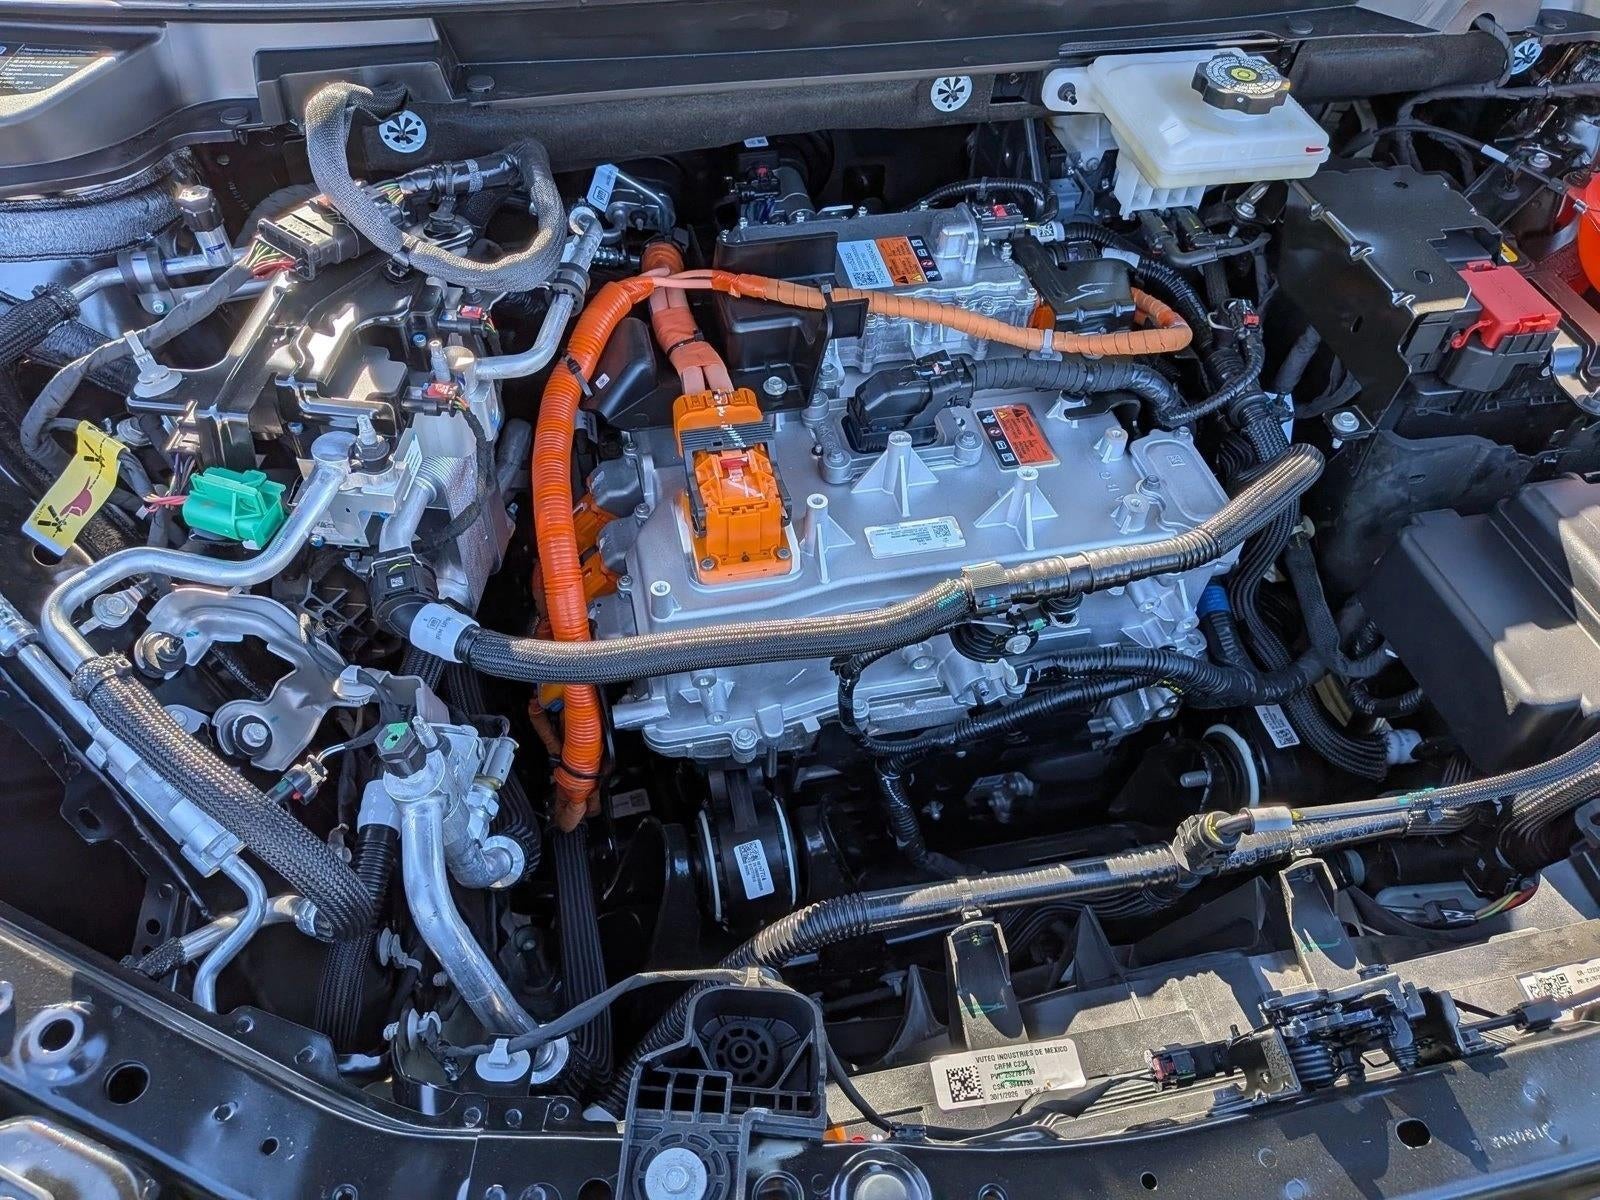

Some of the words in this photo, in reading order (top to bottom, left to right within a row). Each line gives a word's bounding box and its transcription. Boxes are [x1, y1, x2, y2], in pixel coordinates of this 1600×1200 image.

[975, 1054, 996, 1063] VUTEQ
[997, 1049, 1034, 1060] INDUSTRIES
[1035, 1048, 1043, 1056] DE
[1044, 1045, 1068, 1055] MEXICO
